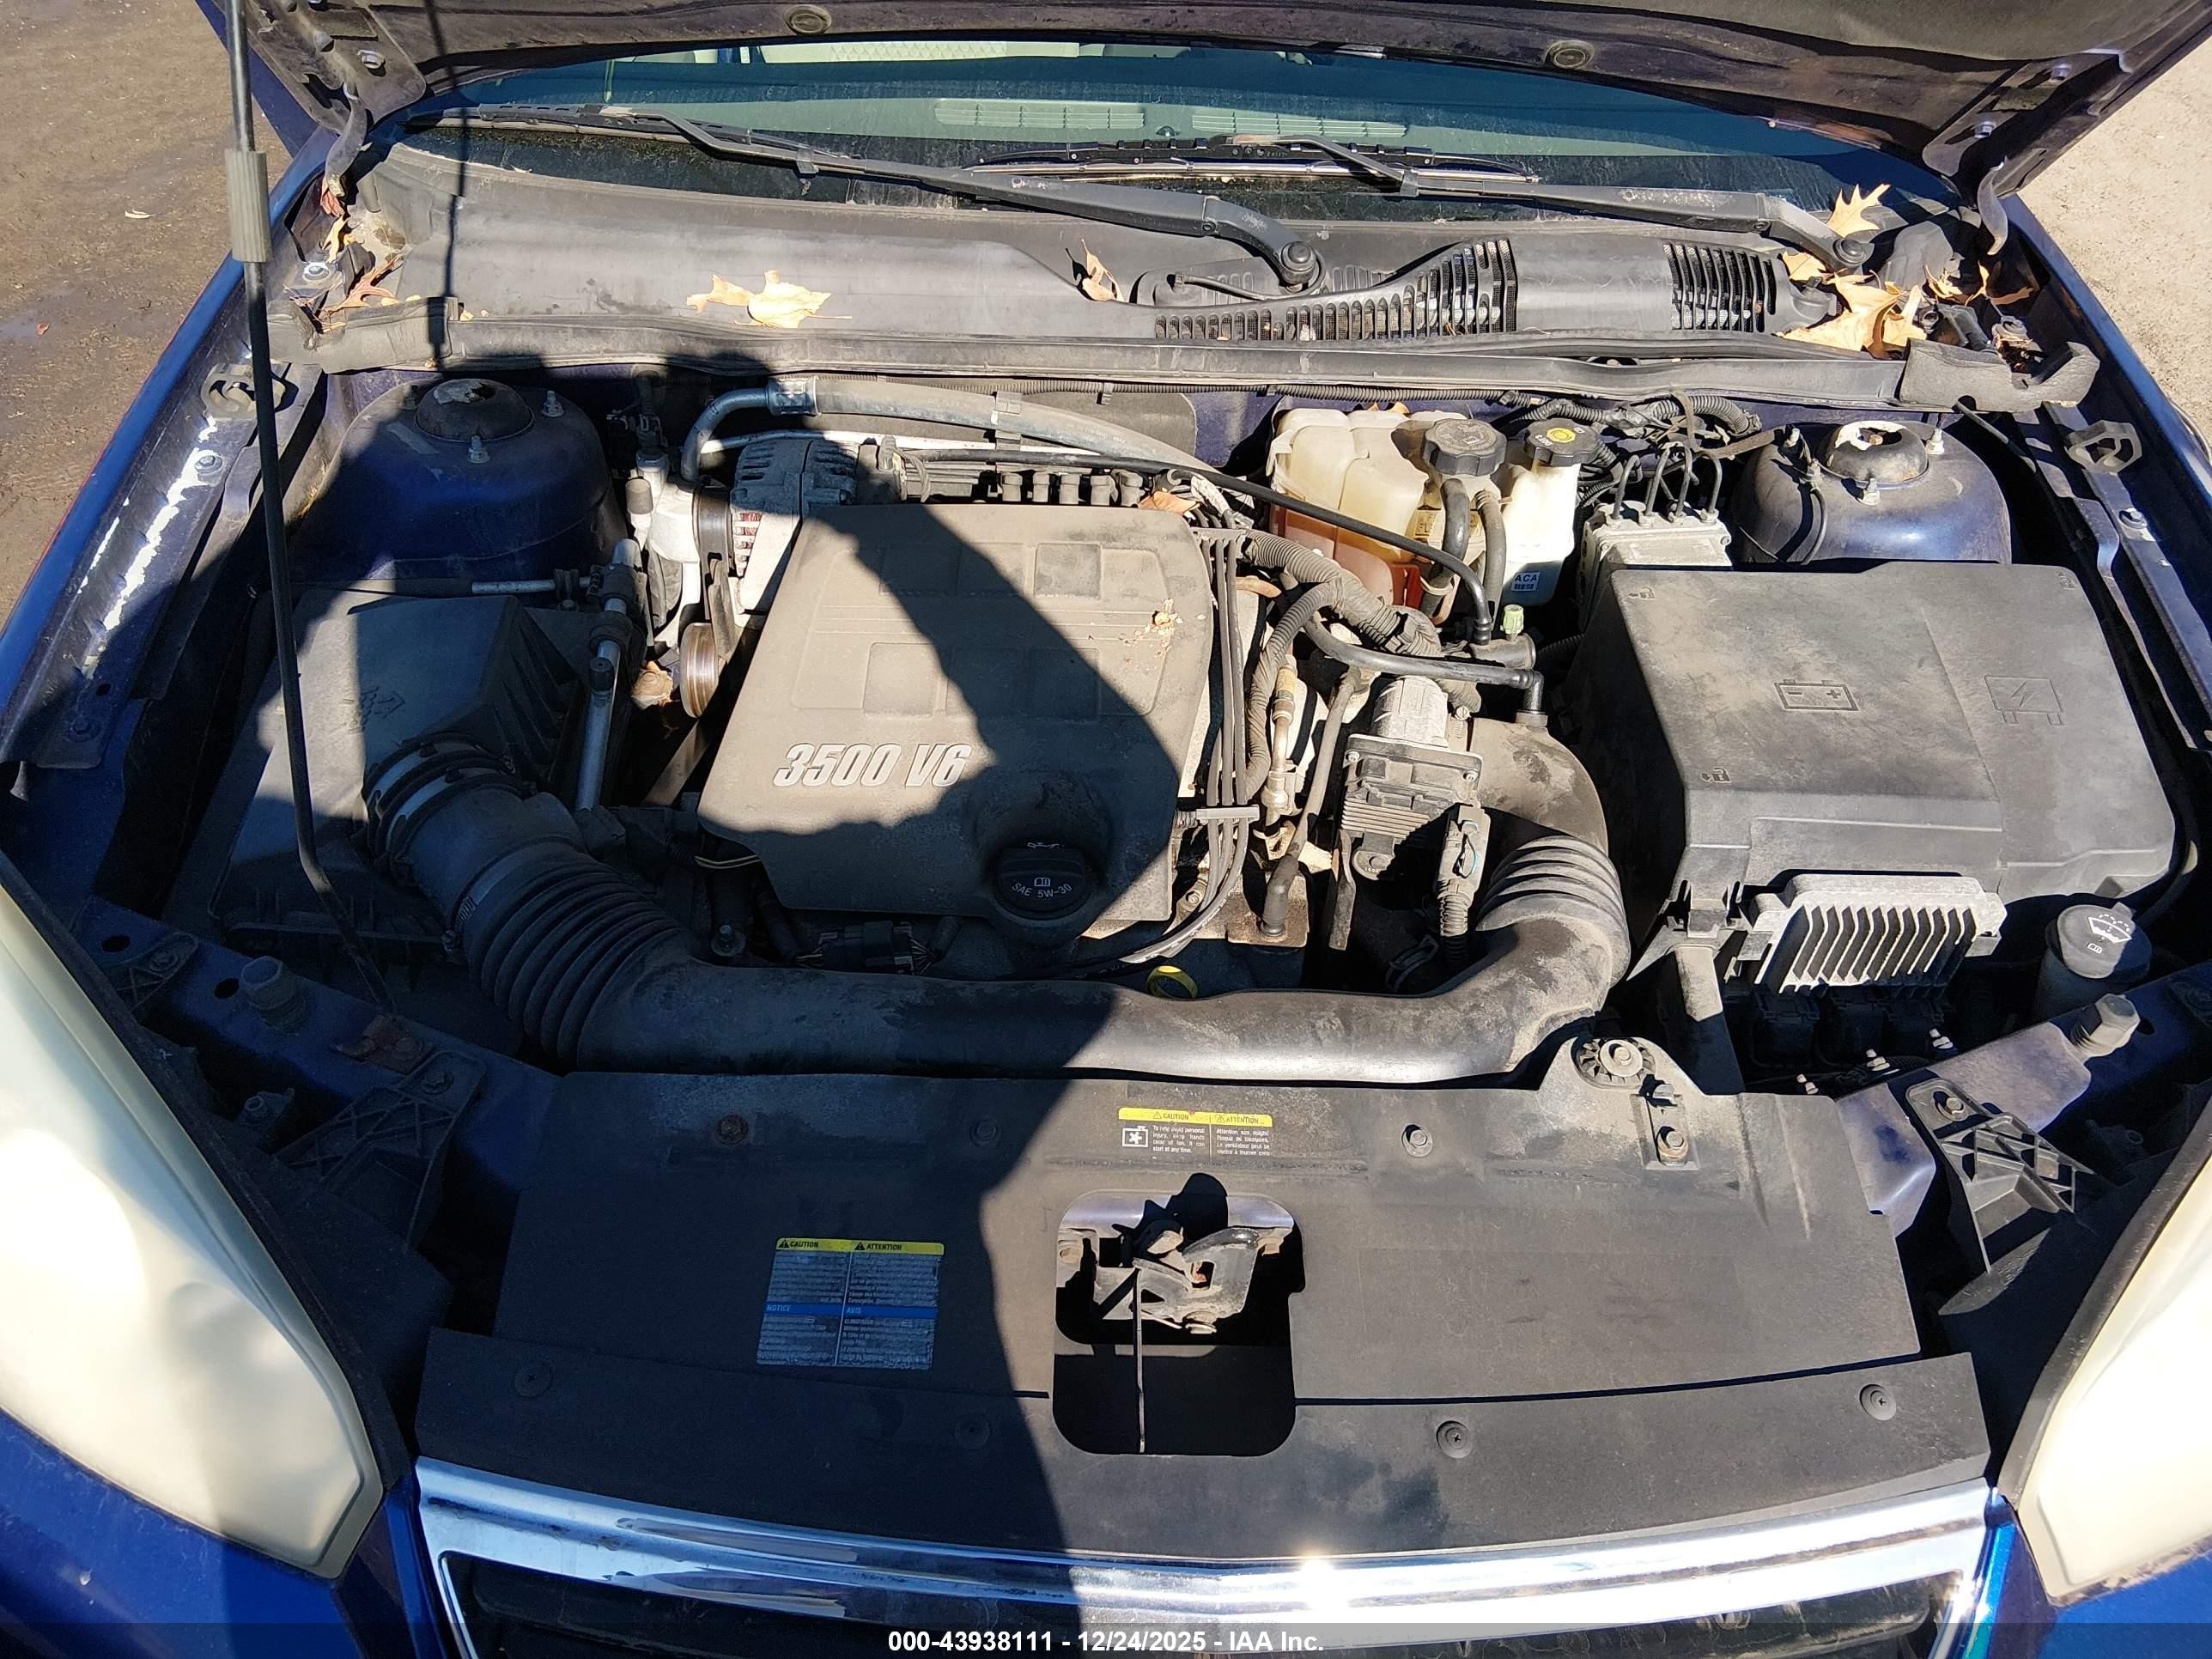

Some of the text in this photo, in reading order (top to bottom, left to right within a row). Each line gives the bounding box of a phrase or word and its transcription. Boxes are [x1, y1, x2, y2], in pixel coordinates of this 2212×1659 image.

[1514, 574, 1537, 582] ACA
[773, 743, 972, 787] 3500 V6
[1012, 883, 1073, 898] SAE 5W-30
[866, 1243, 902, 1251] ATTENTION
